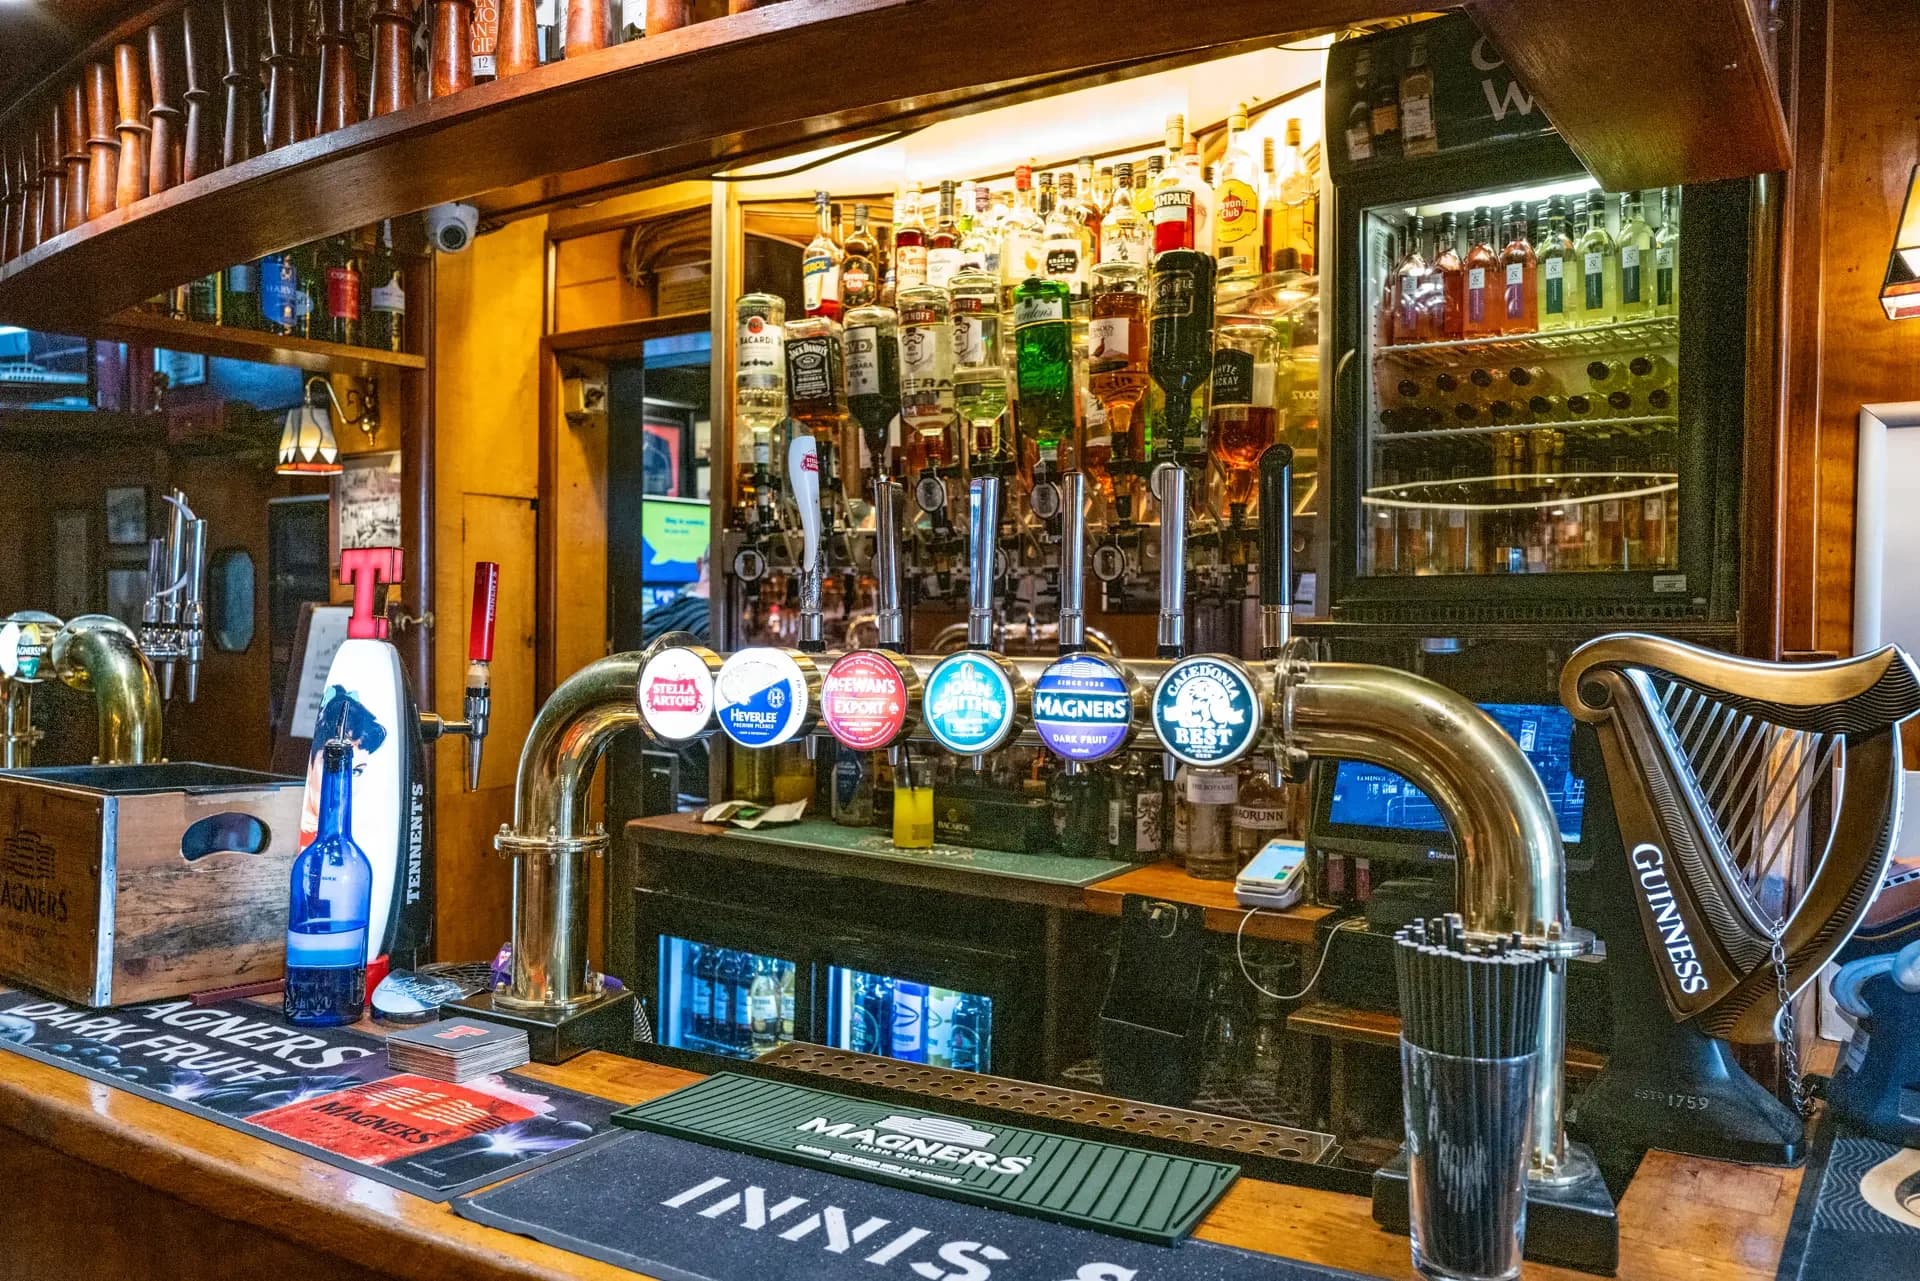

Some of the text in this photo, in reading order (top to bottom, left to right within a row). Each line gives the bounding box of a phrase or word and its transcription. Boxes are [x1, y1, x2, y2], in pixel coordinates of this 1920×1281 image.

[478, 57, 489, 69] 12
[1154, 191, 1192, 208] AMPARI
[740, 335, 774, 345] BACARDI
[340, 546, 403, 640] T
[653, 682, 696, 696] STELLA
[942, 679, 993, 699] JOHN
[1166, 664, 1241, 701] CALEDONIA
[653, 694, 697, 707] ARTOIS
[834, 700, 885, 715] EXPORT
[1035, 695, 1128, 719] MAGNERS
[1052, 733, 1108, 745] DARK FRUIT
[1174, 726, 1233, 746] BEST
[406, 781, 424, 905] TENNENT'S
[1632, 843, 1709, 994] GUINNESS
[1, 1002, 287, 1083] DARK FRUIT
[141, 1000, 376, 1069] AGNERS
[1668, 1094, 1709, 1110] 1759
[310, 1100, 440, 1145] MAGNERS
[795, 1116, 1033, 1175] MAGNERS
[895, 1152, 937, 1165] CIDER
[660, 1176, 1009, 1281] INNIS
